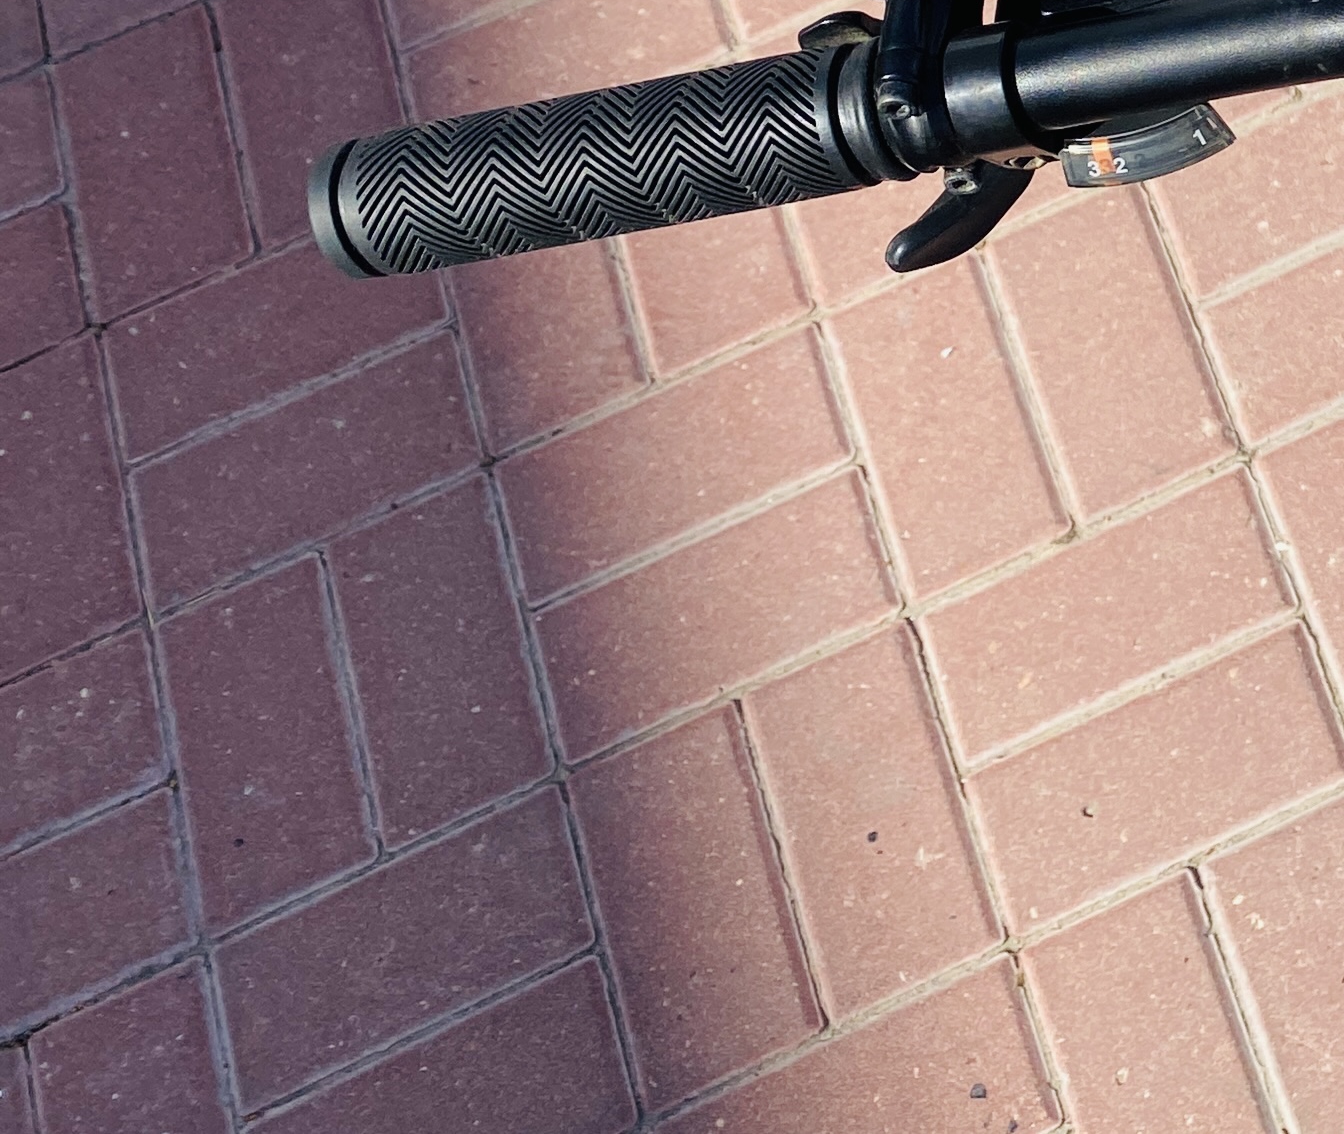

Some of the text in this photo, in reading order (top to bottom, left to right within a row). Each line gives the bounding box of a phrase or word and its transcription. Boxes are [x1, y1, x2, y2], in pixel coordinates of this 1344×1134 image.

[1087, 128, 1208, 177] 3 2 1
